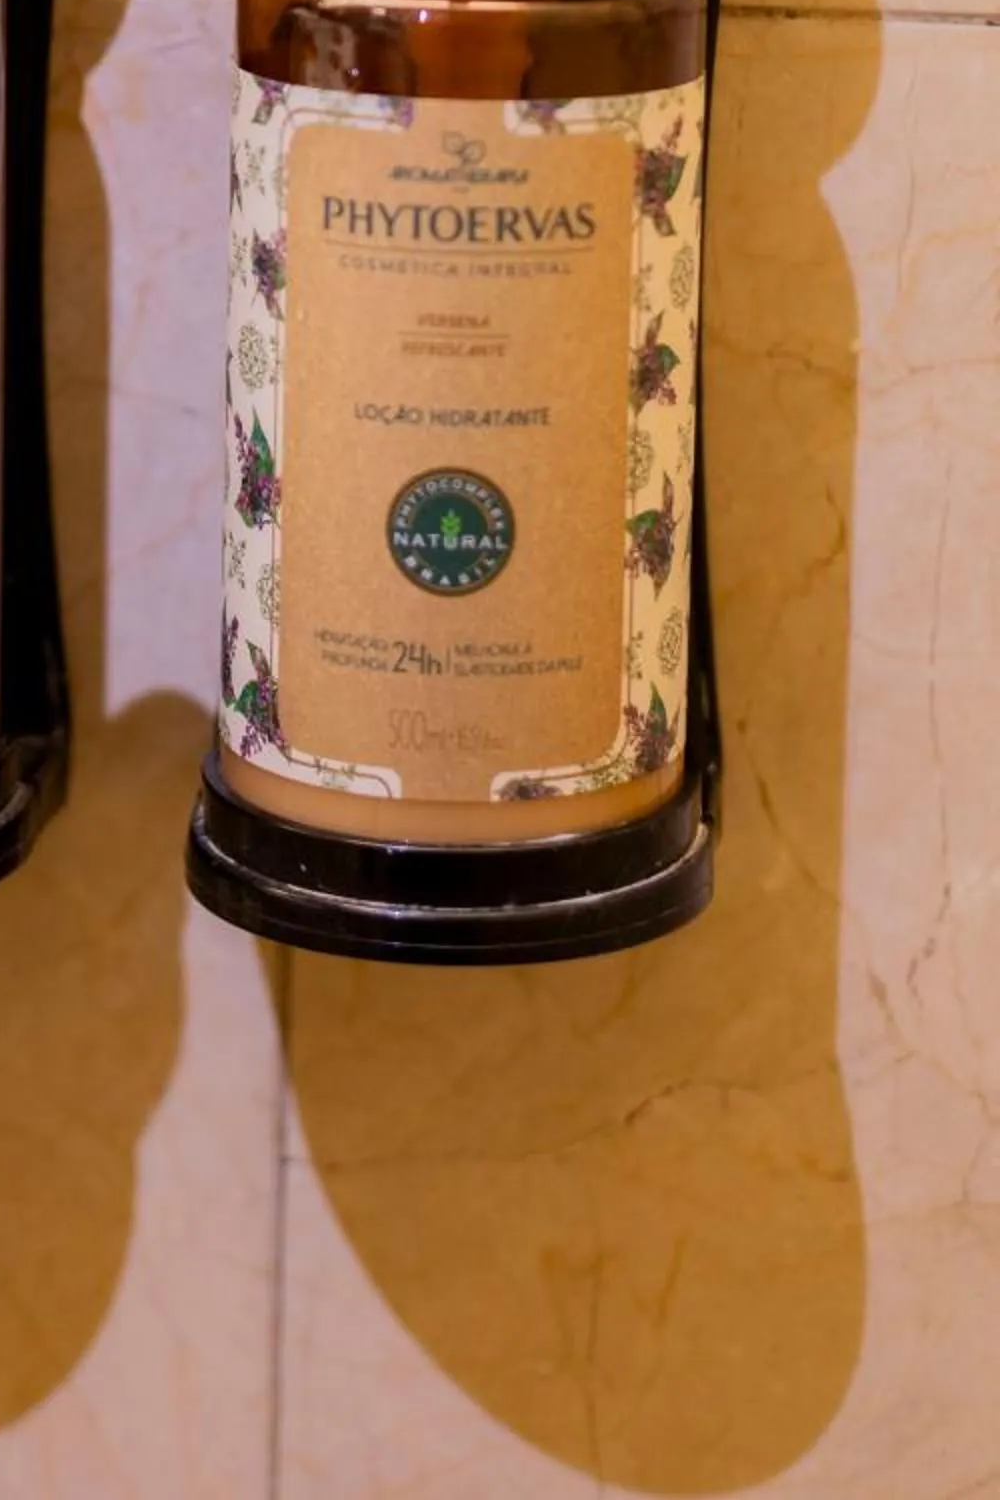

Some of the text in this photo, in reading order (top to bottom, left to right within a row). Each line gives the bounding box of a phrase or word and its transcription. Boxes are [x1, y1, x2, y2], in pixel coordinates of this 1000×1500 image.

[322, 196, 596, 244] PHYTOERVAS
[354, 403, 550, 426] LOÇÃO HIDRATANTE
[394, 531, 508, 551] NATURAL
[392, 641, 443, 675] 24h
